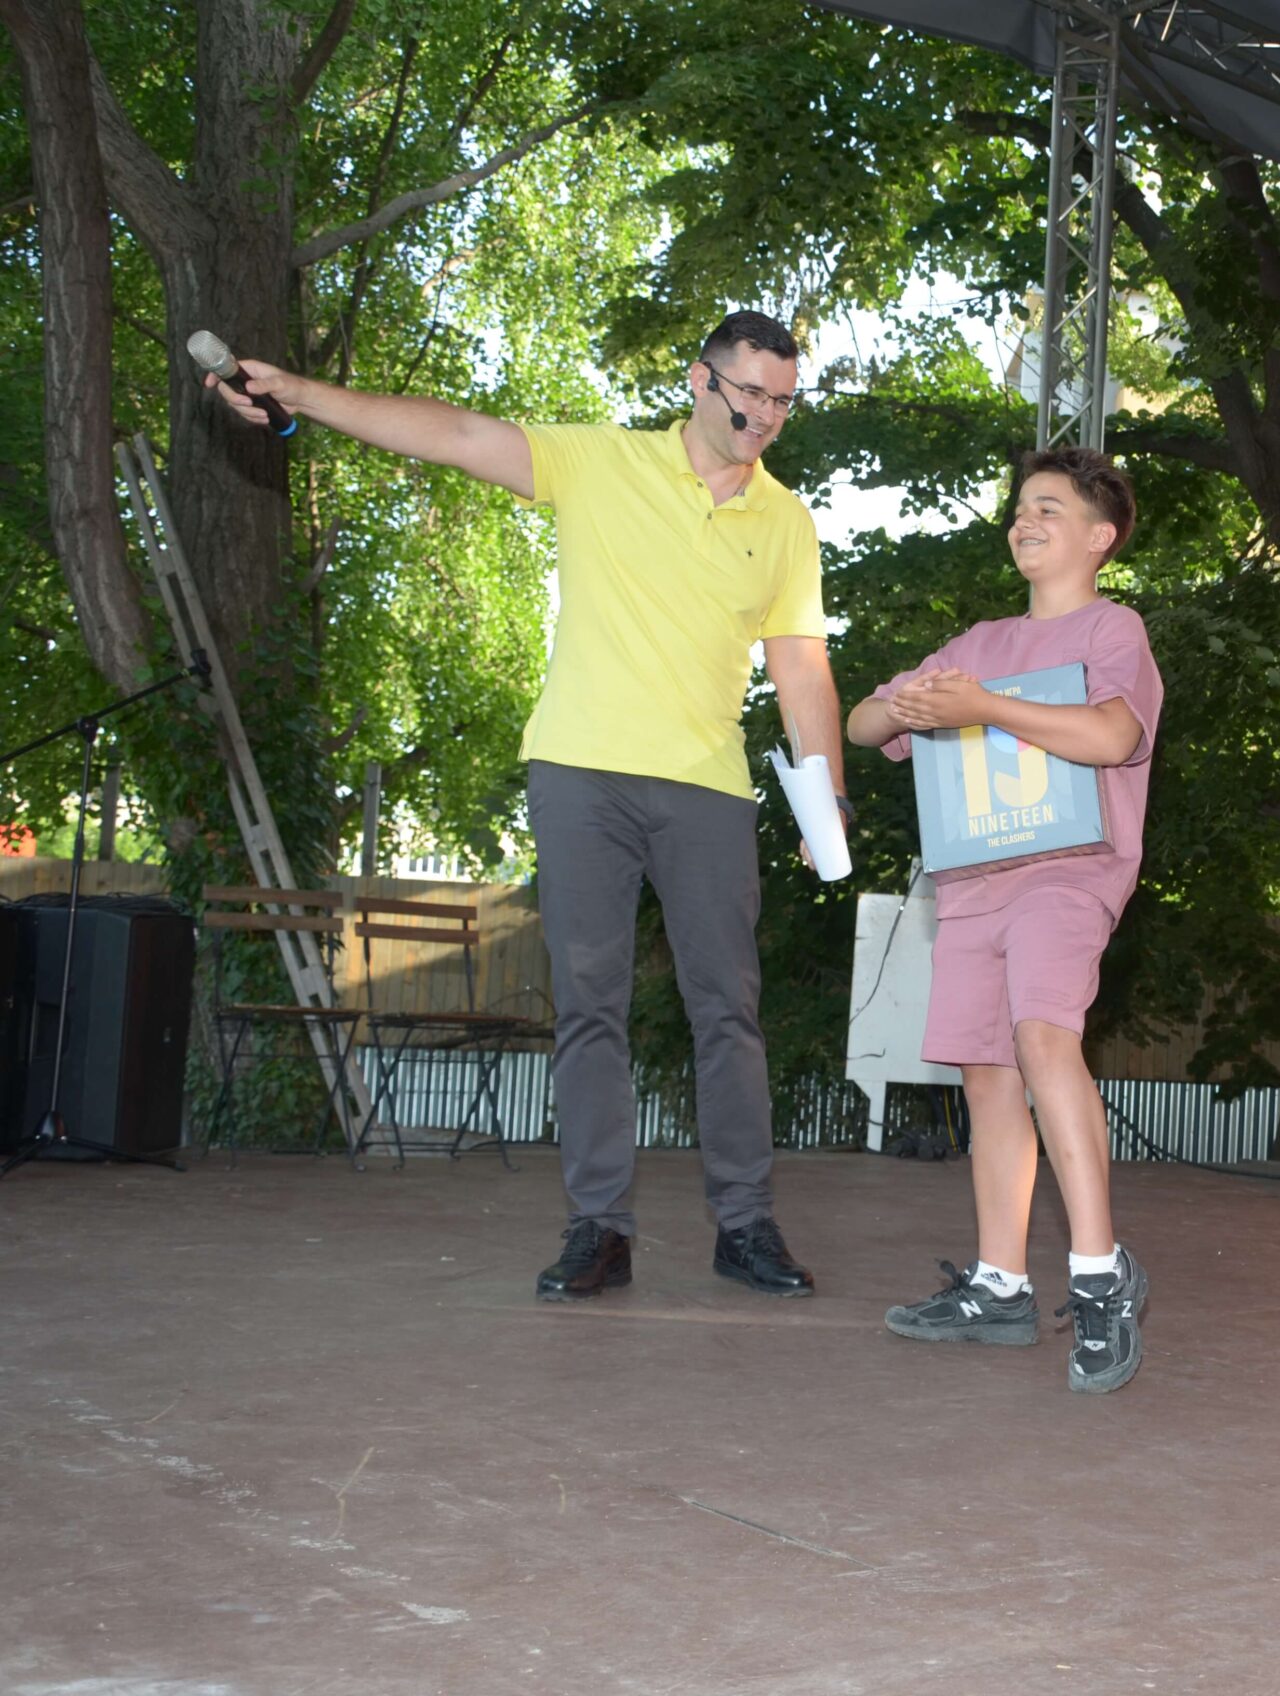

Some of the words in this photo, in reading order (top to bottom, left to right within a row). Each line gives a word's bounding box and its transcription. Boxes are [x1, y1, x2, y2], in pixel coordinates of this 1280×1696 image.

[968, 803, 1054, 838] NINETEEN
[986, 836, 1001, 849] THE
[1001, 830, 1036, 846] CLASHERS
